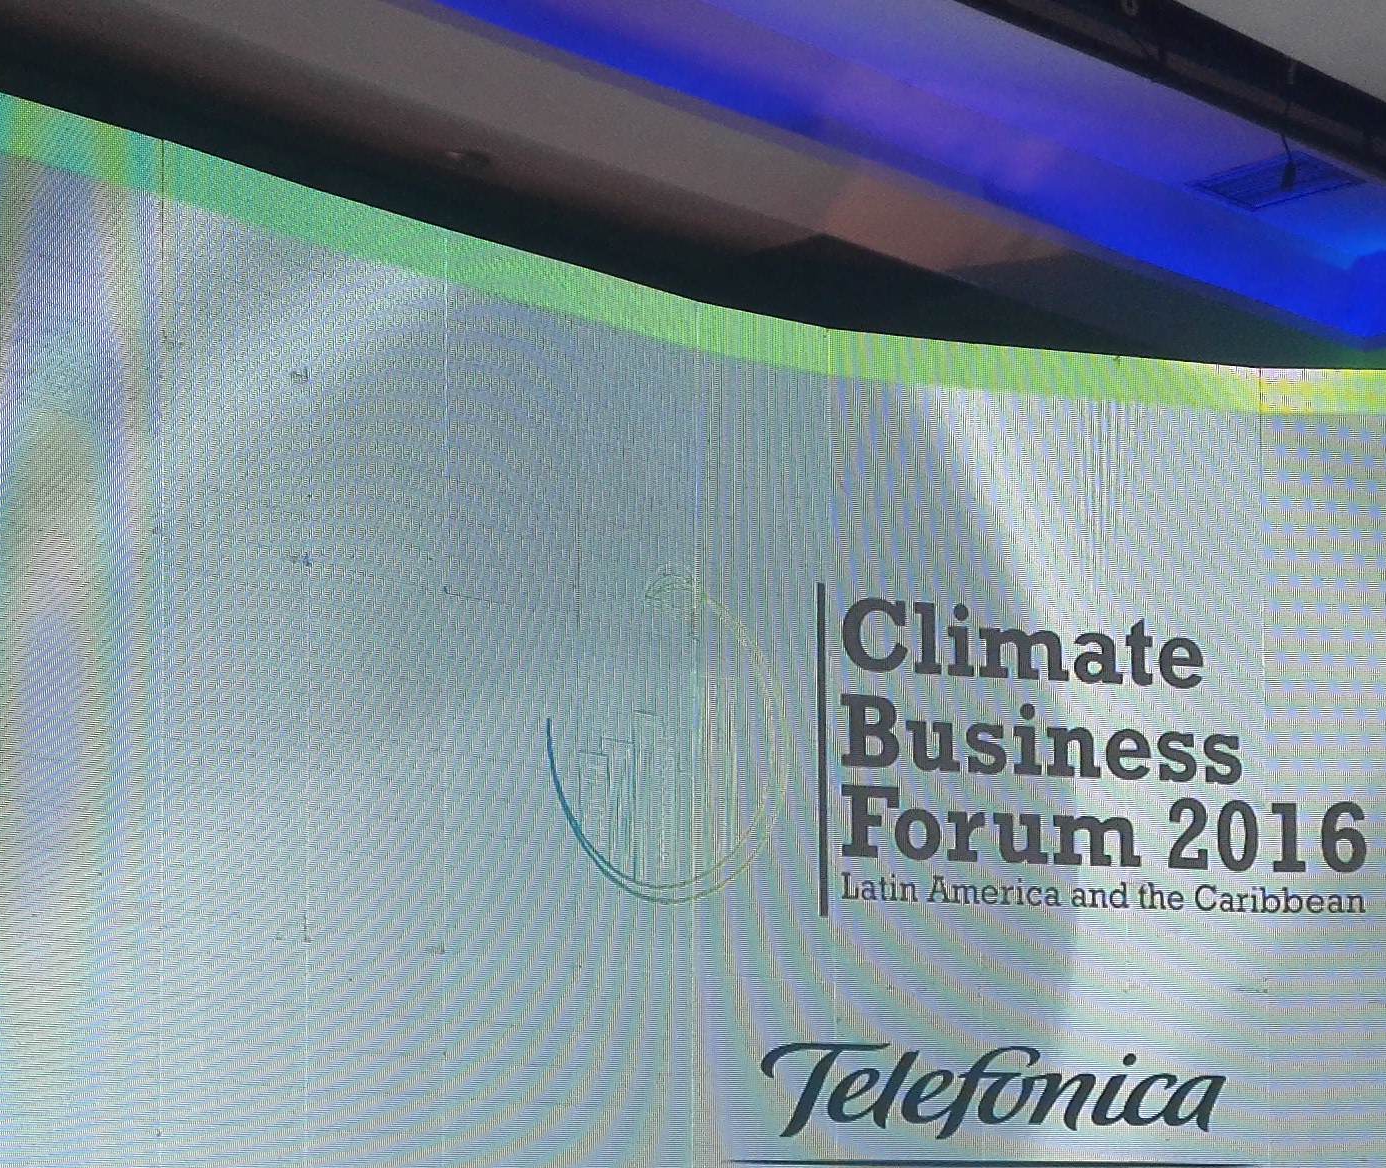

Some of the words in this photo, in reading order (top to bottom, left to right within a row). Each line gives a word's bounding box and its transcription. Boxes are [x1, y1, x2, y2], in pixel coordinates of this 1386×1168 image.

[842, 597, 1205, 690] Climate
[841, 693, 1243, 786] Business
[841, 784, 1141, 868] Forum
[1167, 797, 1368, 873] 2016
[841, 871, 919, 902] Latin
[926, 876, 1061, 908] America
[1072, 881, 1128, 911] and
[1138, 882, 1184, 912] the
[1194, 884, 1367, 915] Caribbean
